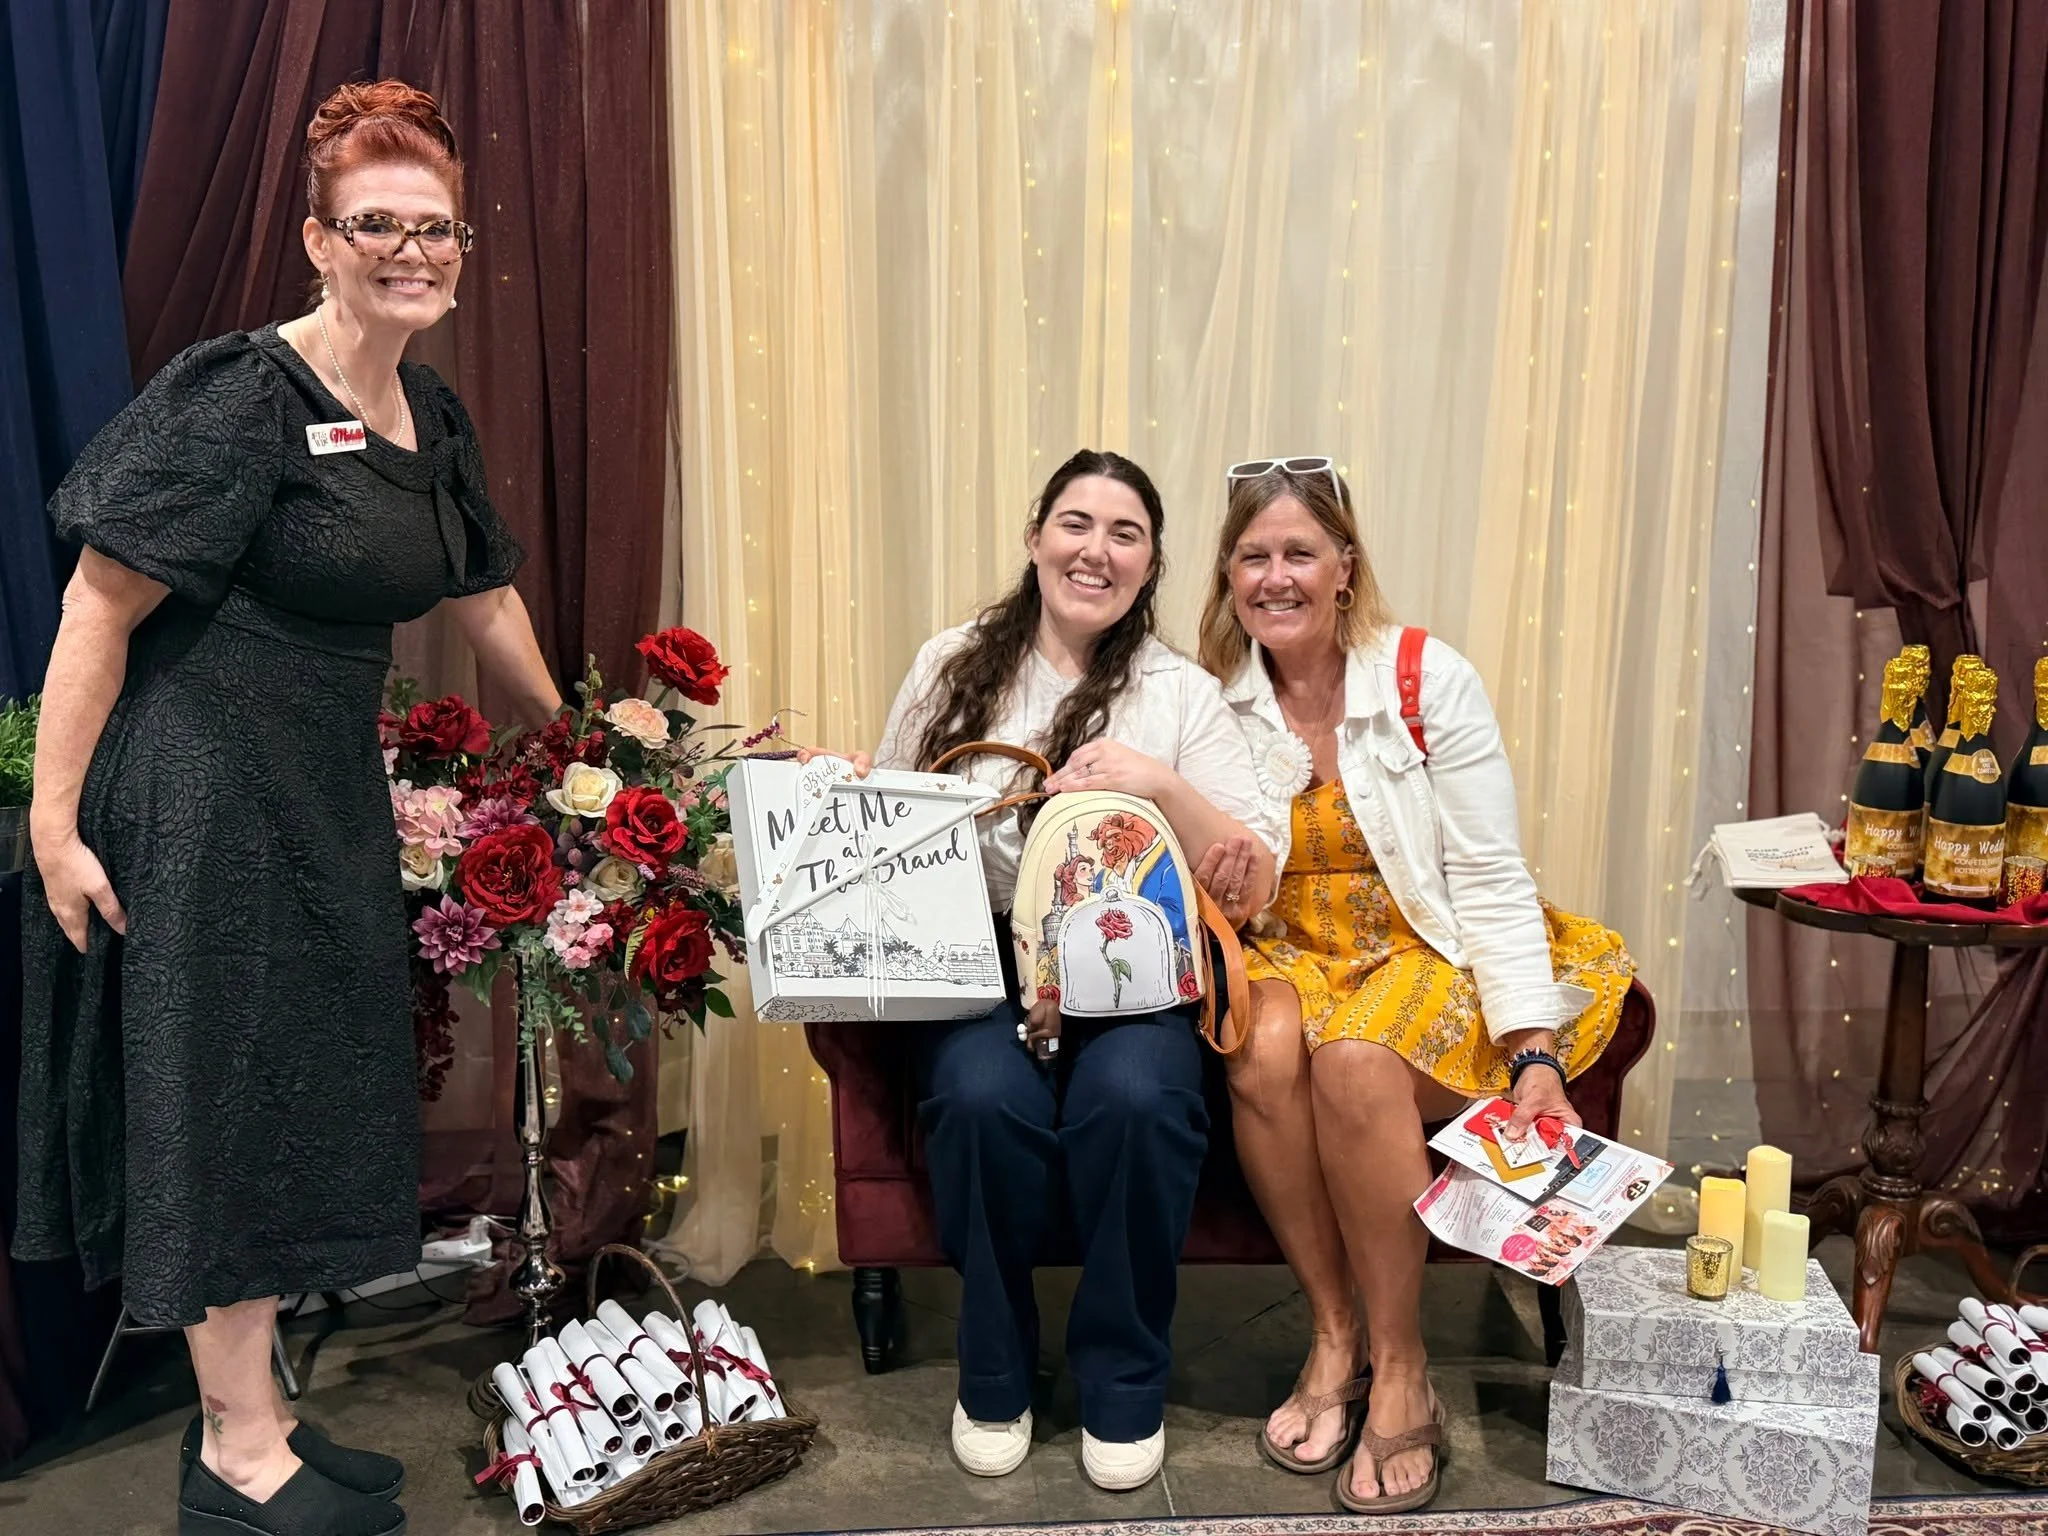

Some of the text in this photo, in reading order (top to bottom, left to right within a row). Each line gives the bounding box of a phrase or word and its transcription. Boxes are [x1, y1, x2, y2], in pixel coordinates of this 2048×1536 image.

[800, 756, 841, 791] Bride
[859, 791, 912, 832] Me
[842, 829, 866, 859] at
[1864, 822, 1904, 842] Happy
[1934, 835, 1971, 857] Happy
